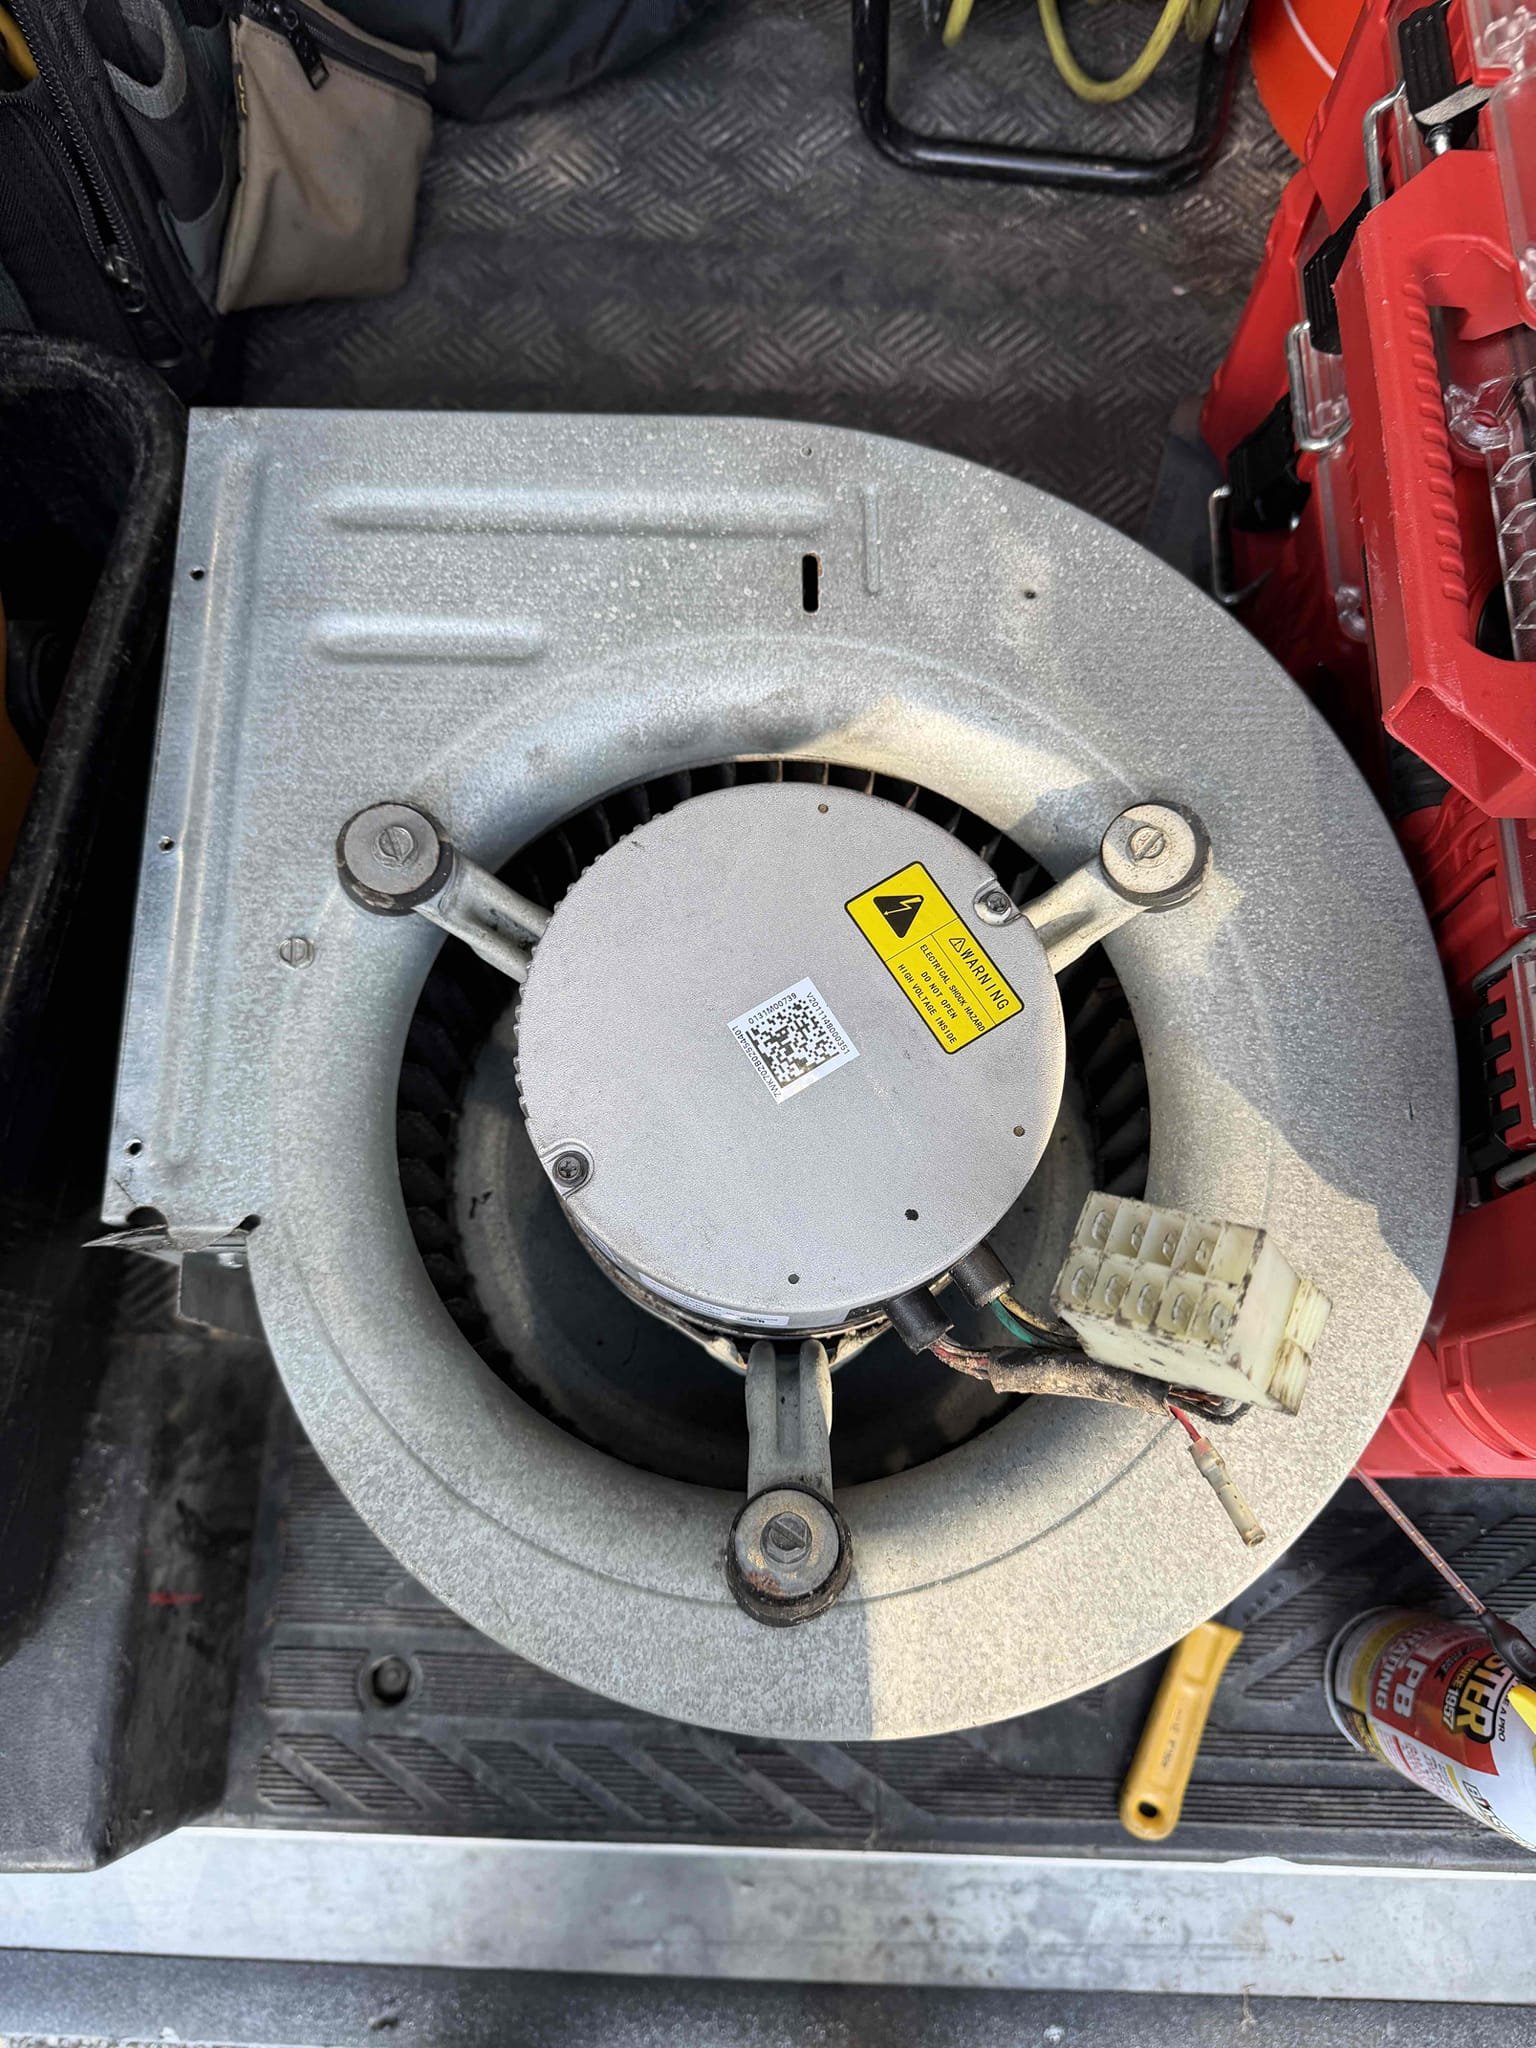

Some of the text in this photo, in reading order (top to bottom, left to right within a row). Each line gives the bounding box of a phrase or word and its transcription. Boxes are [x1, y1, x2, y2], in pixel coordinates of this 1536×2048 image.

[897, 964, 957, 1044] HIGH VOLTAGE INSIDE
[919, 944, 986, 1032] ELECTRICAL SHOCK HAZARD
[920, 971, 958, 1019] DO NOT OPEN
[961, 948, 1009, 1010] WARNING
[748, 992, 797, 1025] 0131M00739
[1392, 1659, 1426, 1718] PB
[1444, 1688, 1461, 1729] 1957
[1498, 1720, 1507, 1742] PRO
